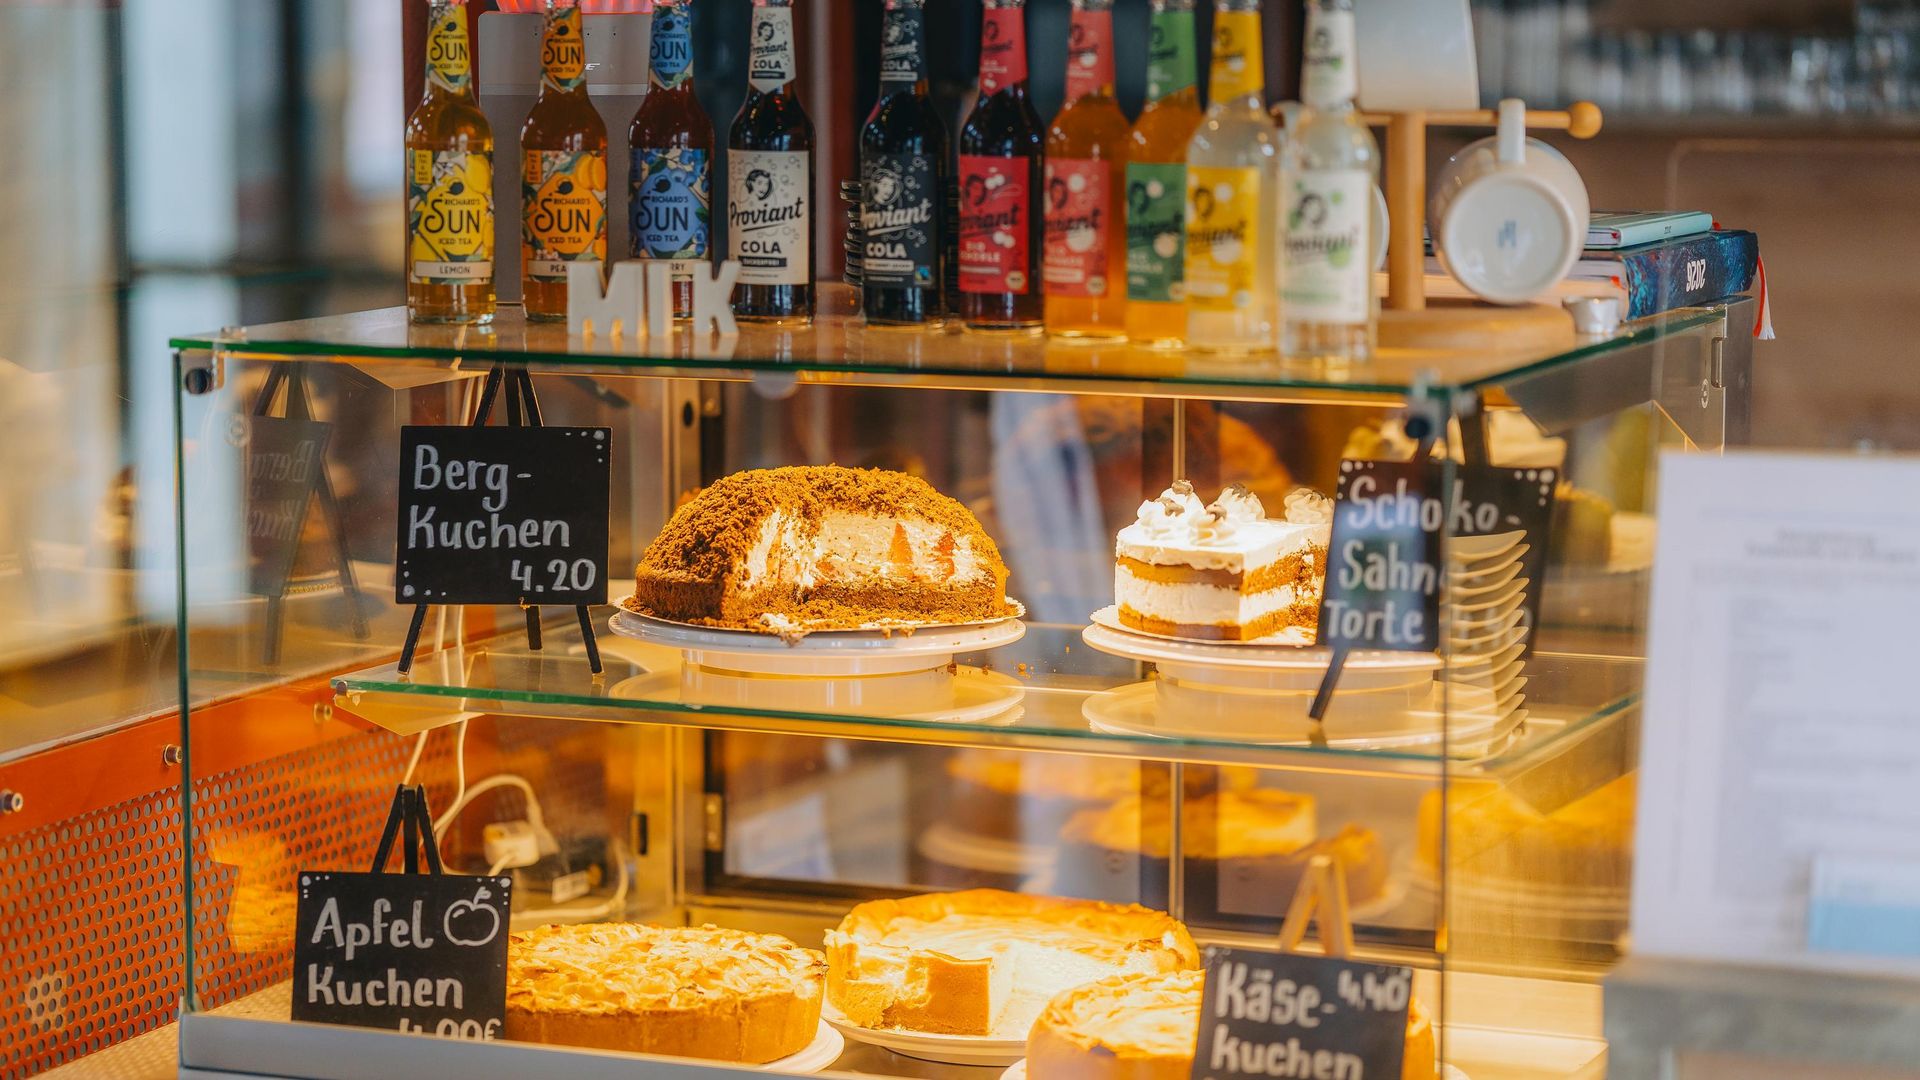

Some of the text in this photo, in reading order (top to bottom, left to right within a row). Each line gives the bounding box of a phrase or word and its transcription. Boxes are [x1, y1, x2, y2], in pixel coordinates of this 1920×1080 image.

[430, 33, 469, 62] SUN
[543, 38, 581, 65] SUN
[650, 34, 687, 60] SUN
[753, 59, 782, 69] COLA
[882, 60, 912, 70] COLA
[424, 197, 480, 234] SUN
[534, 197, 590, 233] SUN
[635, 195, 688, 232] SUN
[729, 196, 804, 229] Proviant
[438, 237, 472, 245] ICED TEA
[548, 236, 582, 244] ICED TEA
[664, 235, 679, 243] TEA
[740, 241, 782, 254] COLA
[866, 242, 907, 258] COLA
[439, 265, 471, 274] LEMON
[550, 264, 567, 272] PEA
[1685, 258, 1706, 293] 2026
[412, 444, 532, 512] Berg-
[407, 504, 570, 549] Kuchen
[511, 558, 597, 593] 4.20
[1338, 538, 1446, 596] Sahn
[1324, 599, 1425, 644] Torte
[311, 896, 435, 961] Apfel
[308, 963, 464, 1010] Kuchen
[1214, 961, 1338, 1028] Käse-
[399, 1017, 502, 1041] 400€
